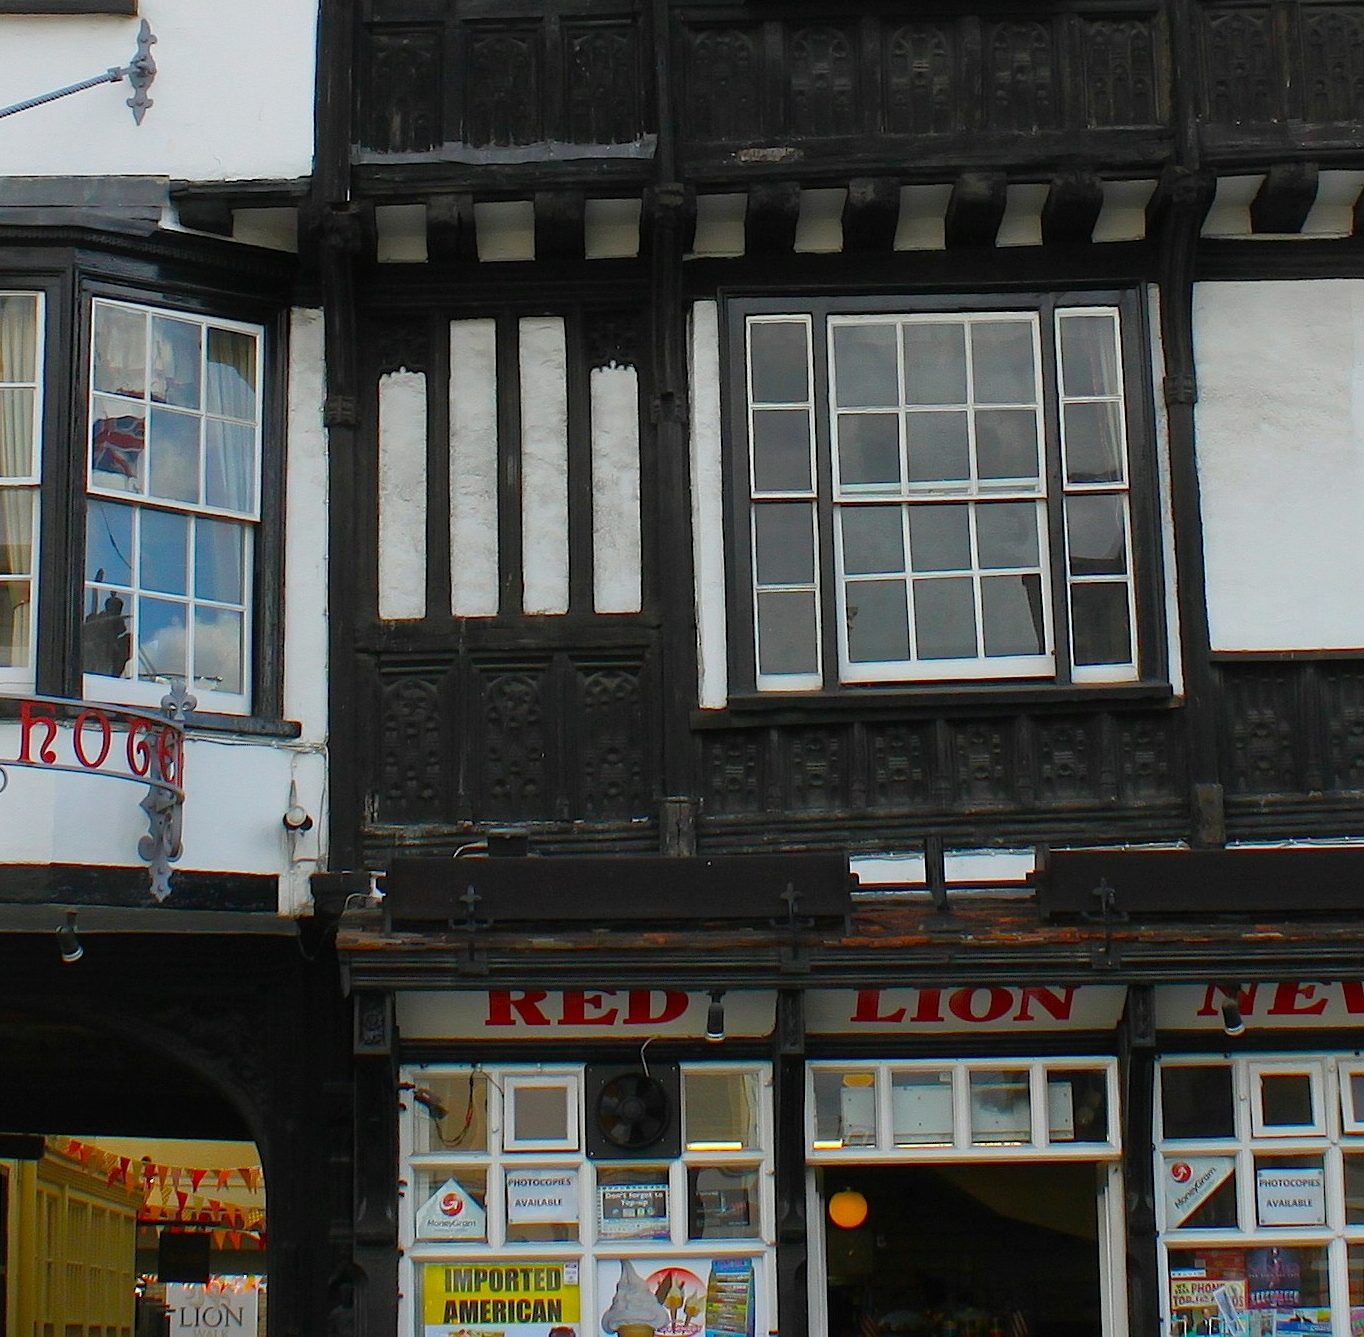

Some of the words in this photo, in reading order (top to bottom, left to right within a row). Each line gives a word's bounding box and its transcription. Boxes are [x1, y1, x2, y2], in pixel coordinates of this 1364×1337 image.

[484, 989, 690, 1026] RED
[849, 986, 1078, 1023] LION
[507, 1177, 572, 1188] PHOTOCOPIES
[1173, 1166, 1218, 1209] MoneyGram
[1258, 1178, 1321, 1188] PHOTOCOPIES
[515, 1198, 563, 1208] AVAILABLE
[1265, 1198, 1313, 1208] AVAILABLE
[427, 1218, 477, 1228] MoneyGram
[444, 1267, 562, 1293] IMPORTED
[179, 1302, 245, 1328] LION
[443, 1298, 563, 1325] AMERICAN
